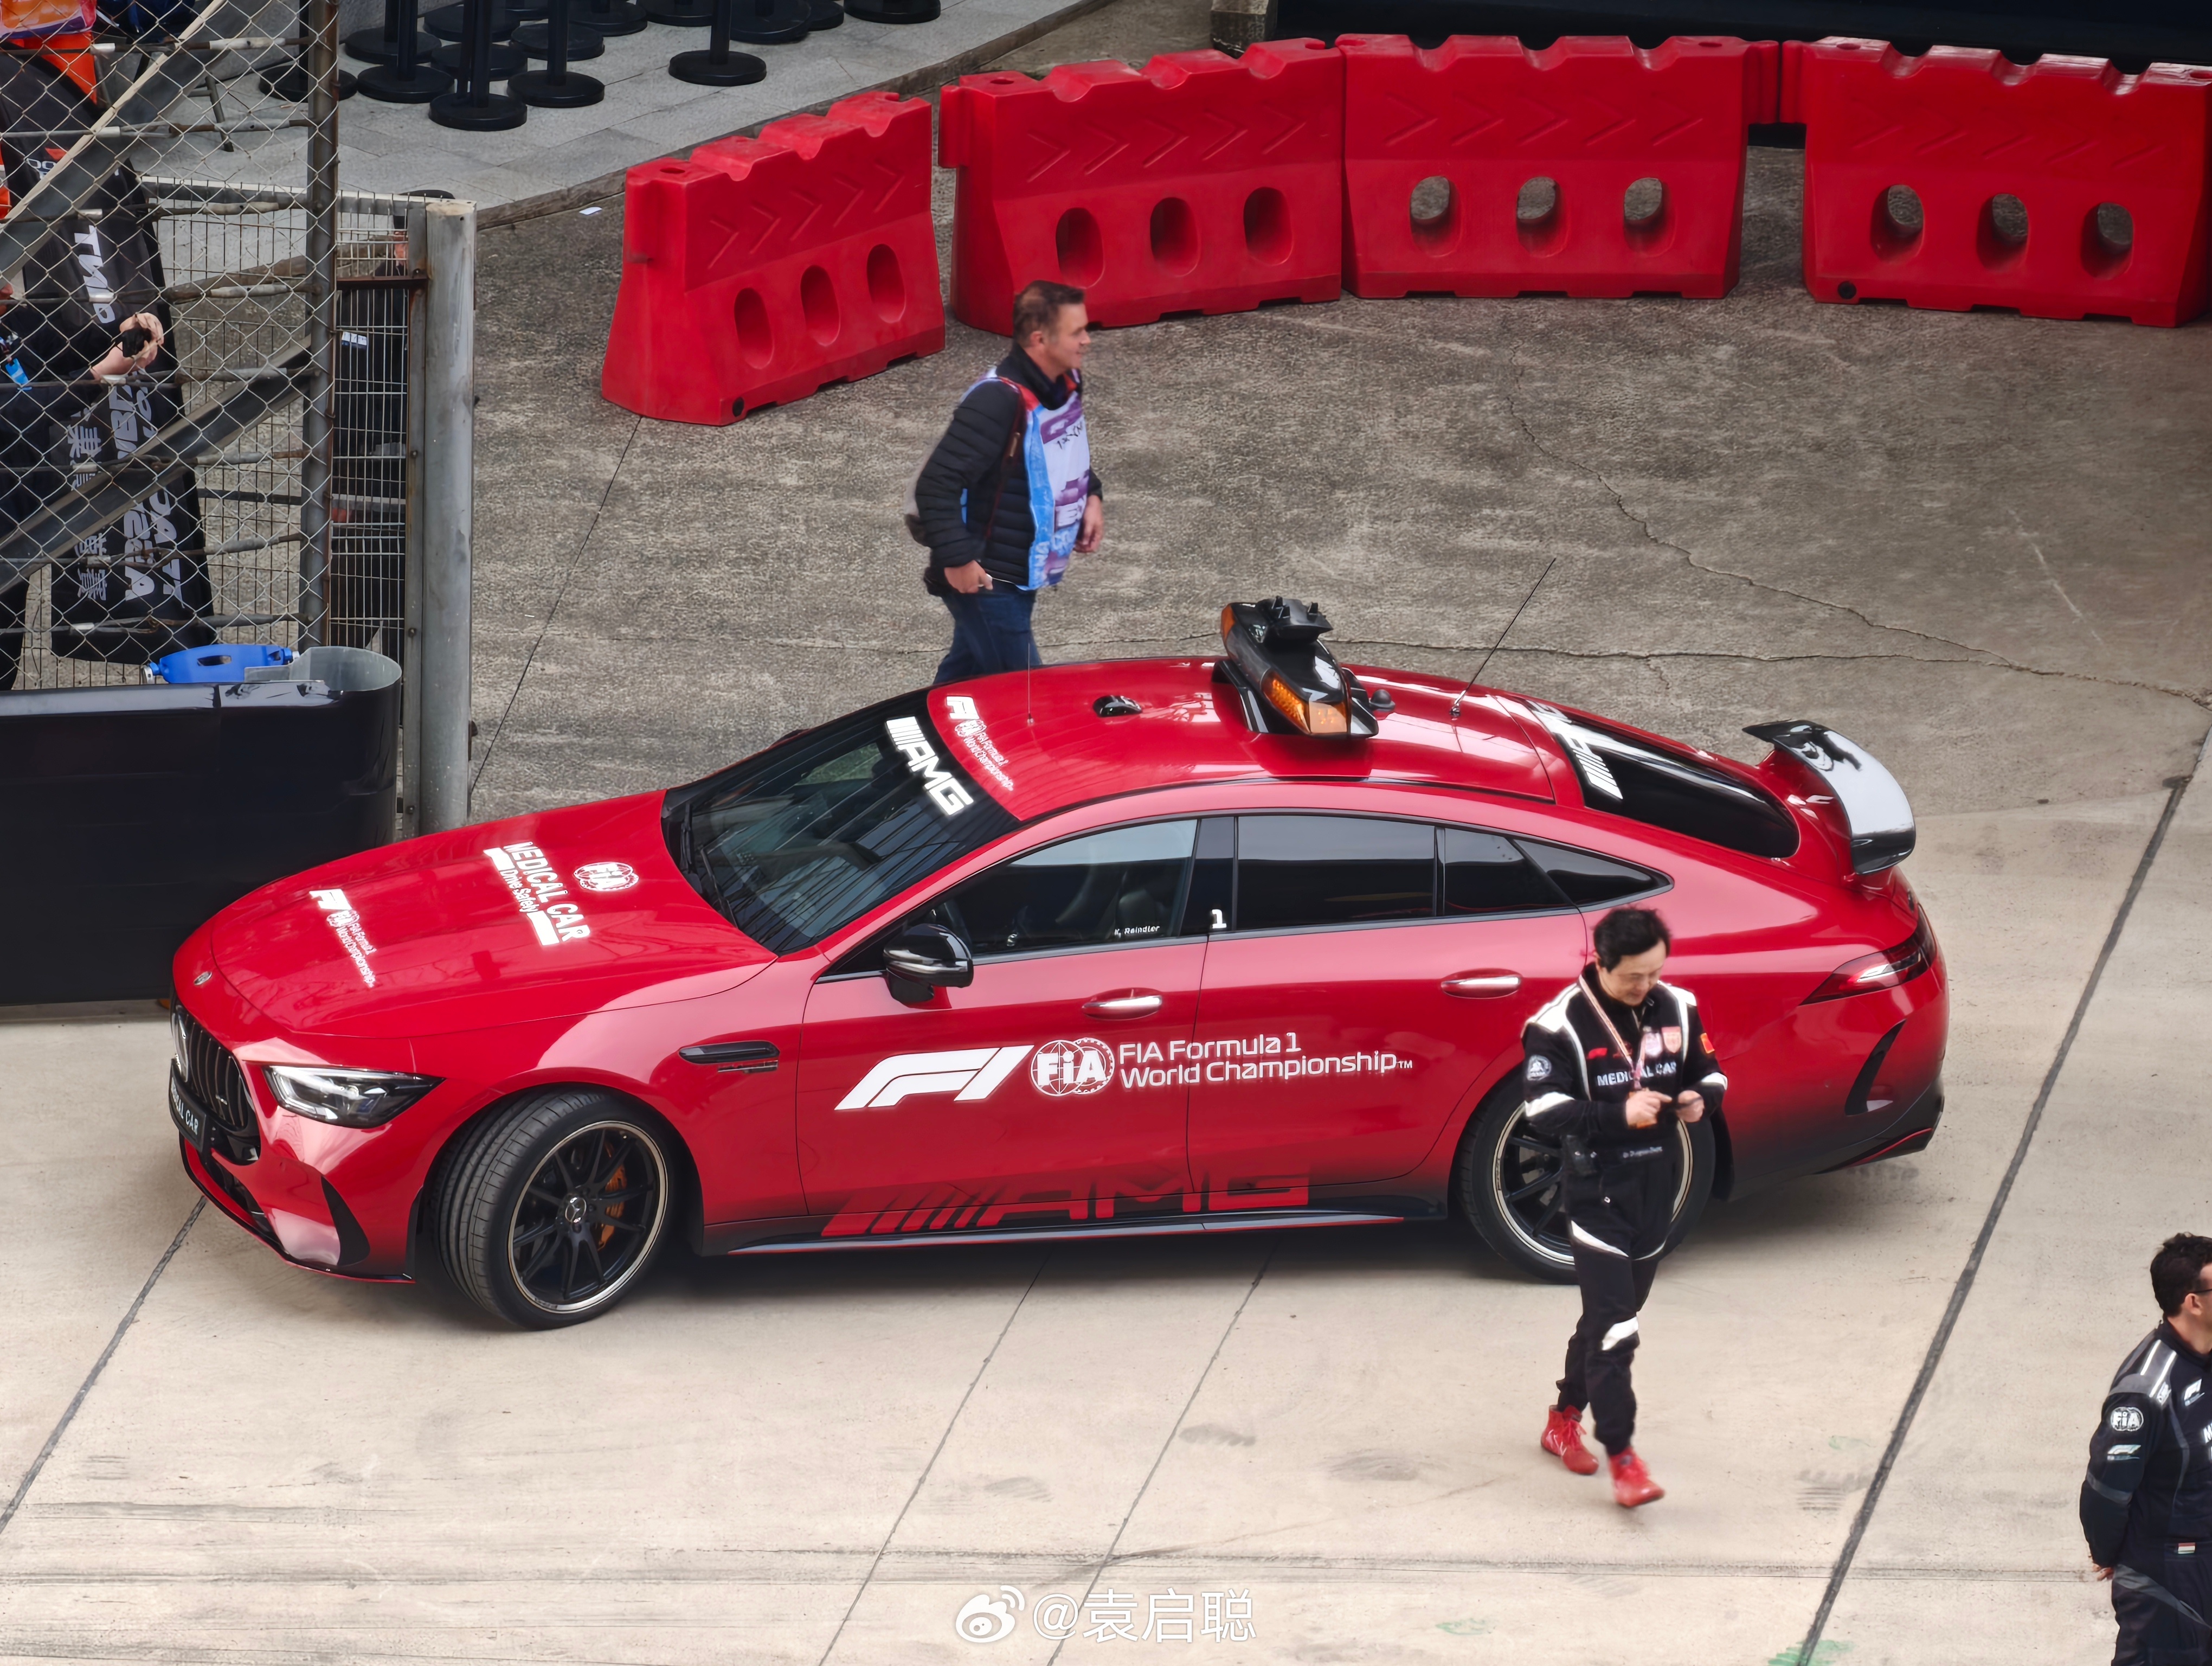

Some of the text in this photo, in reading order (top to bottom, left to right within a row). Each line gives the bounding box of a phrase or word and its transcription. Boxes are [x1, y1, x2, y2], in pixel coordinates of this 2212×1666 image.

[897, 740, 974, 816] AMG
[503, 841, 590, 942] MEDICAL CAR
[512, 888, 540, 912] Safety
[1212, 909, 1227, 929] 1
[1120, 1032, 1302, 1065] FIA Formula 1
[834, 1045, 1034, 1110] F1
[1120, 1063, 1200, 1089] World
[976, 1173, 1309, 1227] AMG
